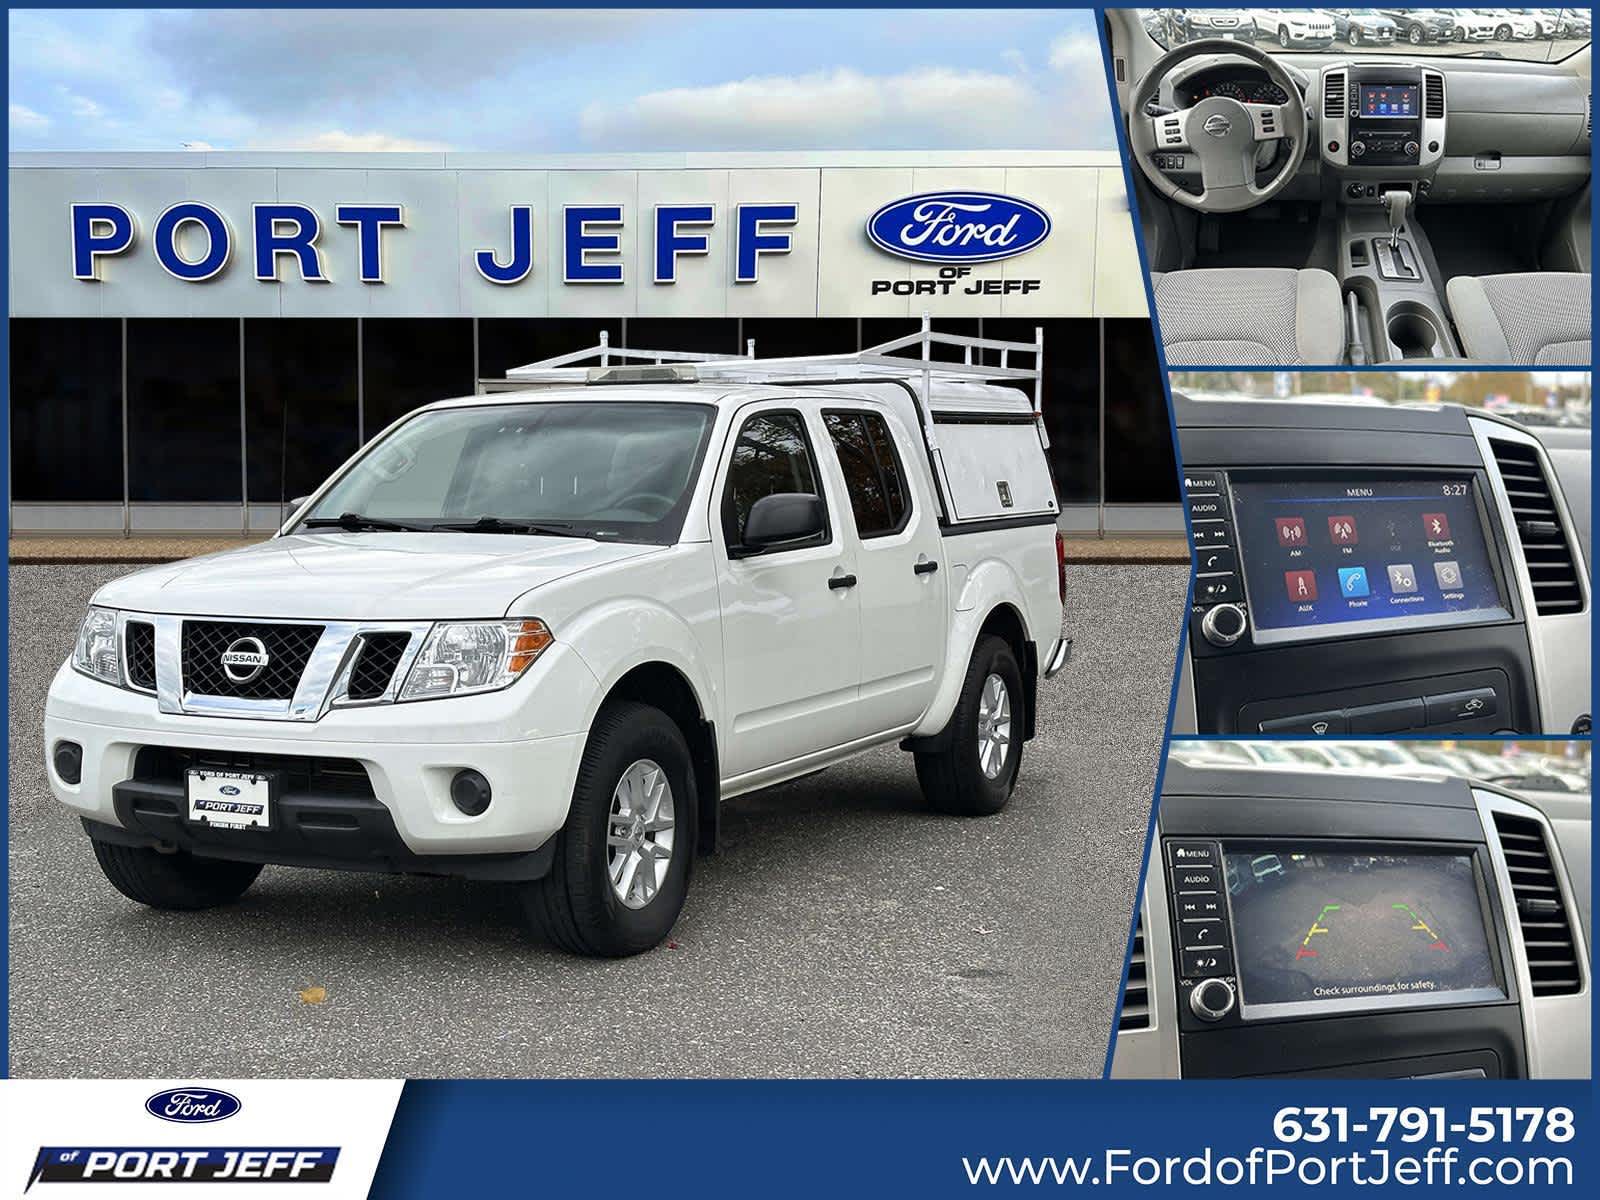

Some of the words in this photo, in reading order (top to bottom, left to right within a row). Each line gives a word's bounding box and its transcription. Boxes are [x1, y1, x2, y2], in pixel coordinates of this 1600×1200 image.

[900, 201, 1021, 247] Ford
[70, 202, 404, 283] PORT
[473, 203, 800, 285] JEFF
[939, 267, 971, 279] OF
[872, 281, 956, 296] PORT
[964, 280, 1041, 295] JEFF
[1347, 488, 1373, 497] MENU
[1442, 485, 1467, 496] 8:27
[1192, 504, 1217, 512] AUDIO
[1298, 604, 1314, 612] AUX
[1349, 600, 1368, 608] Phone
[223, 654, 262, 663] NISSAN
[205, 801, 235, 811] PORT
[235, 803, 261, 814] JEFF
[1186, 850, 1209, 858] MENU
[1313, 986, 1340, 996] Check
[1341, 984, 1396, 995] surroundings
[1397, 981, 1410, 991] for
[1410, 979, 1436, 990] safety.
